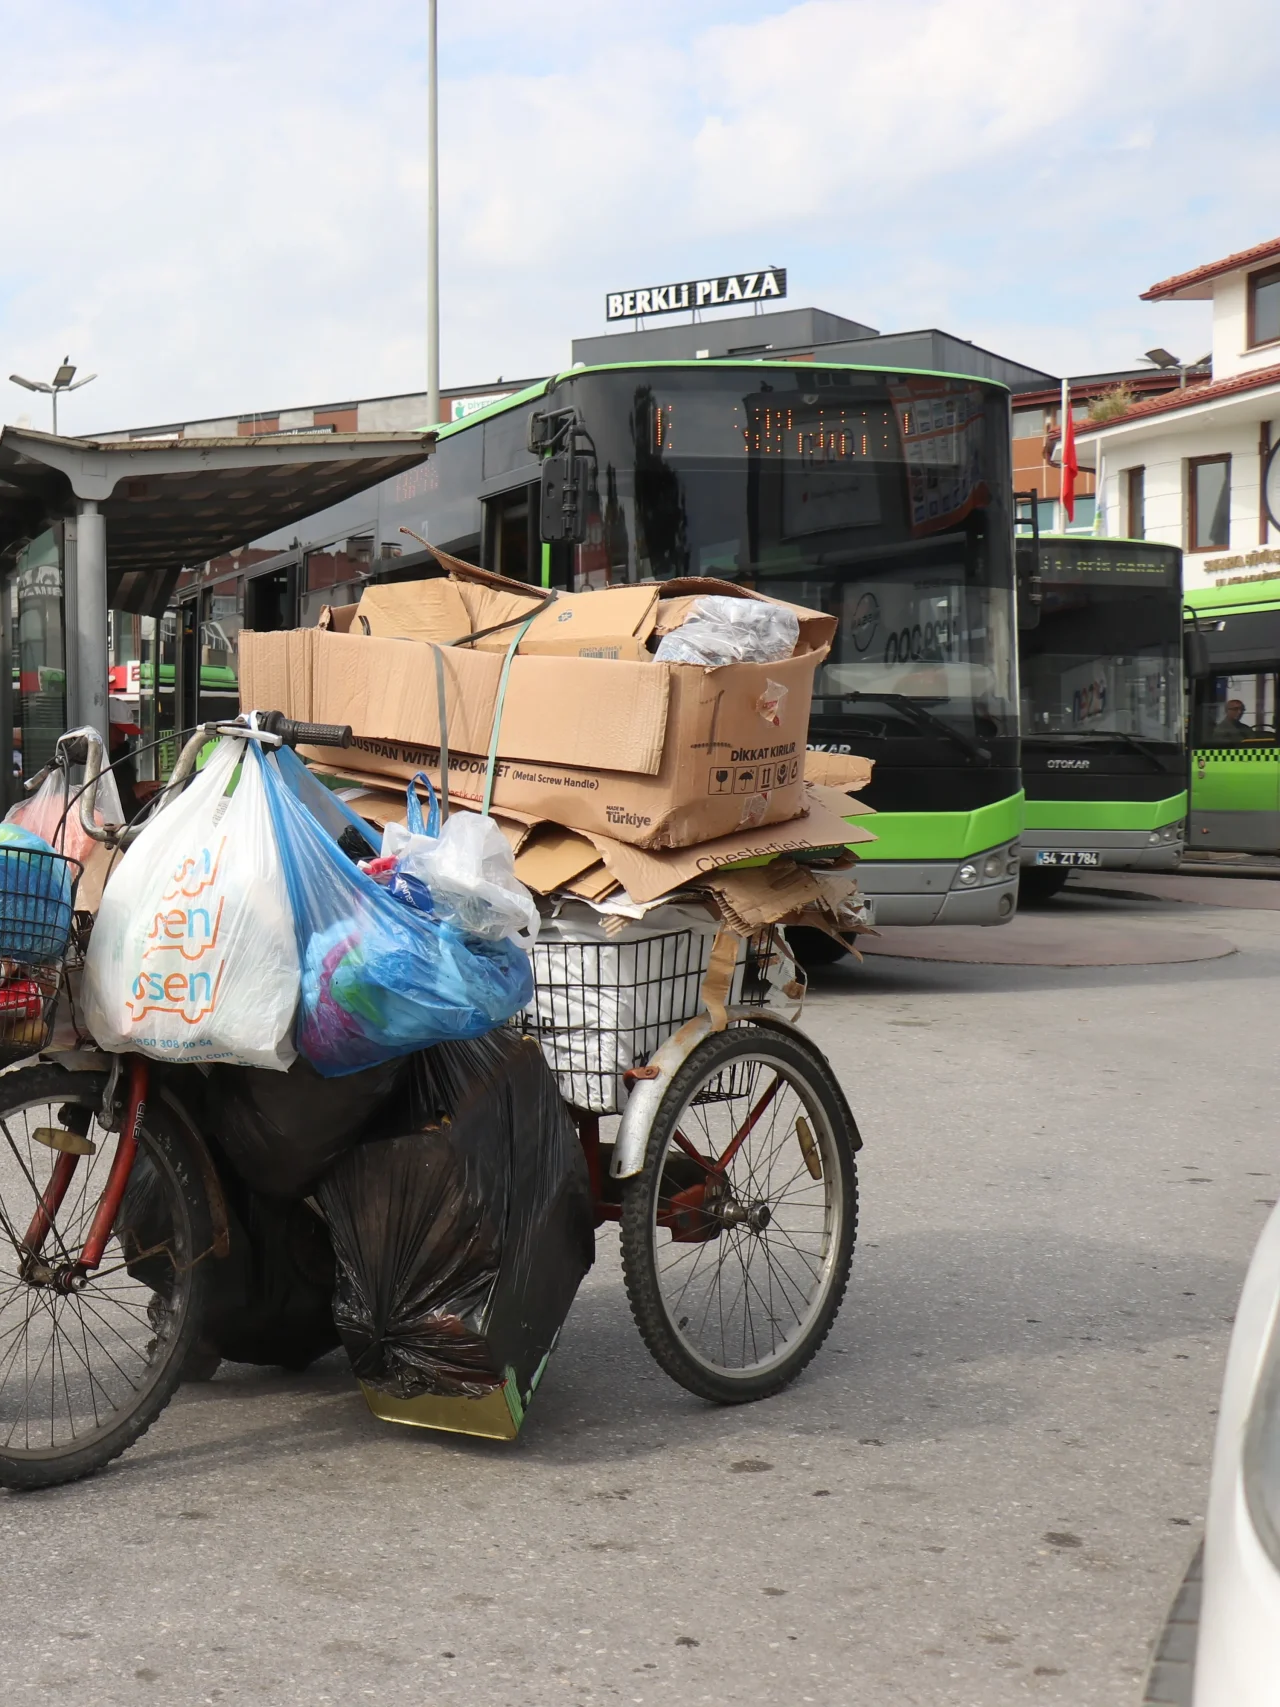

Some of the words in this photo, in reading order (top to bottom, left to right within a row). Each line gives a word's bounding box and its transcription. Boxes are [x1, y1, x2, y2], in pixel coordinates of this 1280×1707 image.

[695, 272, 781, 306] PLAZA
[730, 748, 769, 762] DİKKAT
[402, 749, 440, 768] WITH
[512, 769, 537, 783] (Metal
[537, 773, 562, 786] Screw
[563, 775, 600, 791] Handle)
[1047, 759, 1090, 769] OTOKAR
[606, 811, 651, 828] Türkiye
[696, 839, 813, 872] Chesterfield
[1042, 852, 1057, 865] 54
[1060, 852, 1074, 865] ZT
[1077, 853, 1097, 865] 784
[160, 1039, 180, 1049] 308
[199, 1038, 213, 1047] 54
